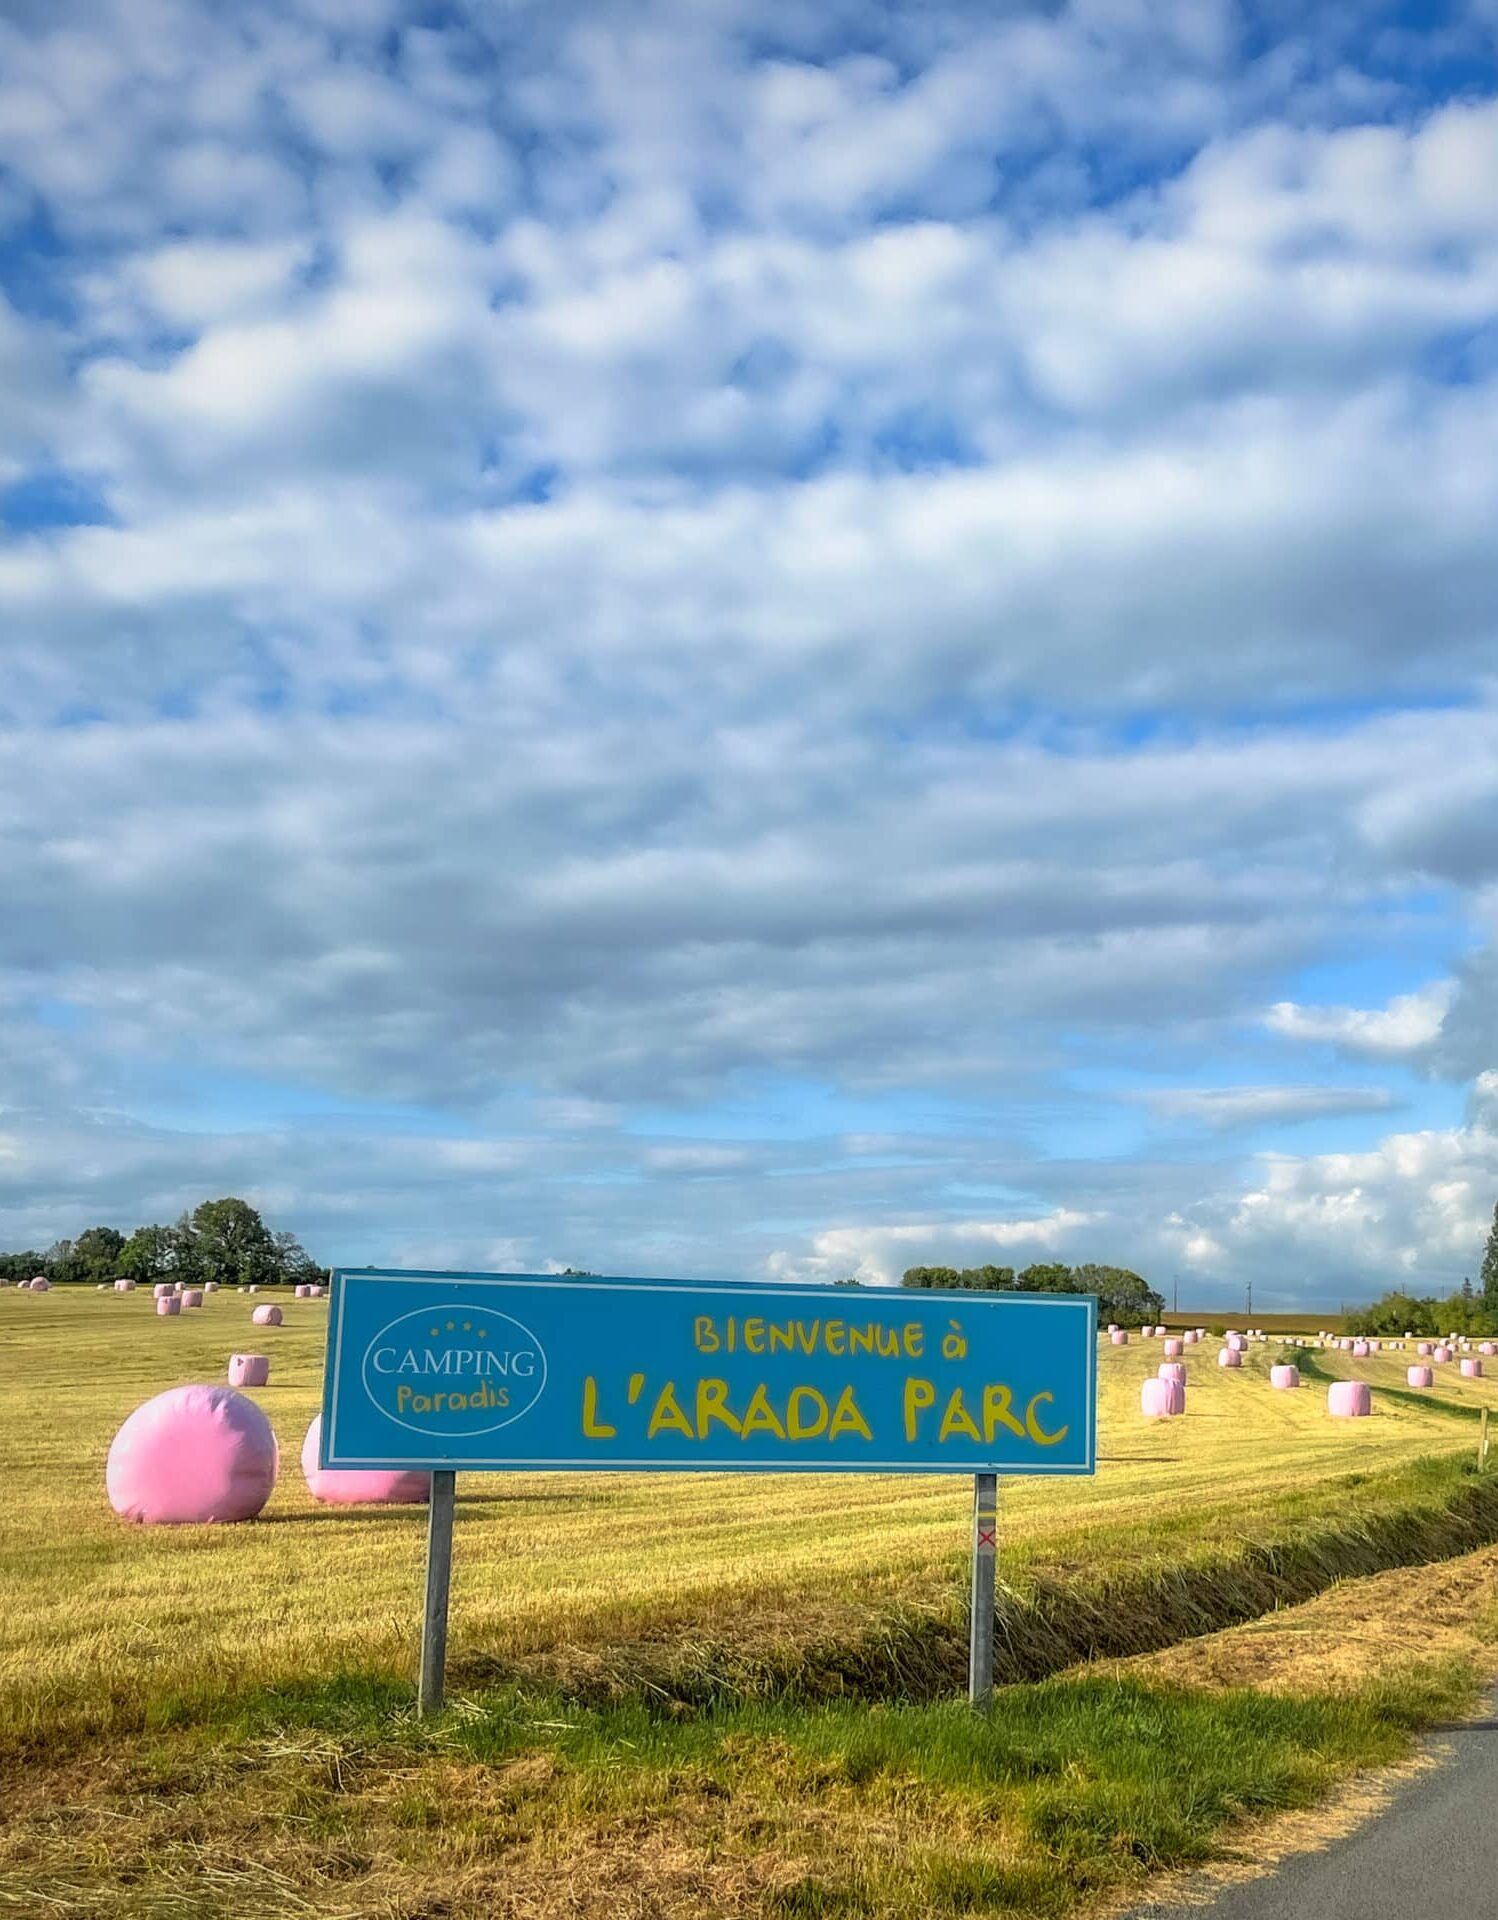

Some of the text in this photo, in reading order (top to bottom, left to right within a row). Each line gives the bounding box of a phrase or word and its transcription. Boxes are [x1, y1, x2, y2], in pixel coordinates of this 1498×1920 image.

[694, 1316, 968, 1359] BIENVENUE à
[372, 1347, 535, 1377] CAMPING
[396, 1379, 510, 1414] Paradis
[582, 1373, 1069, 1446] L'ARADA PARC
